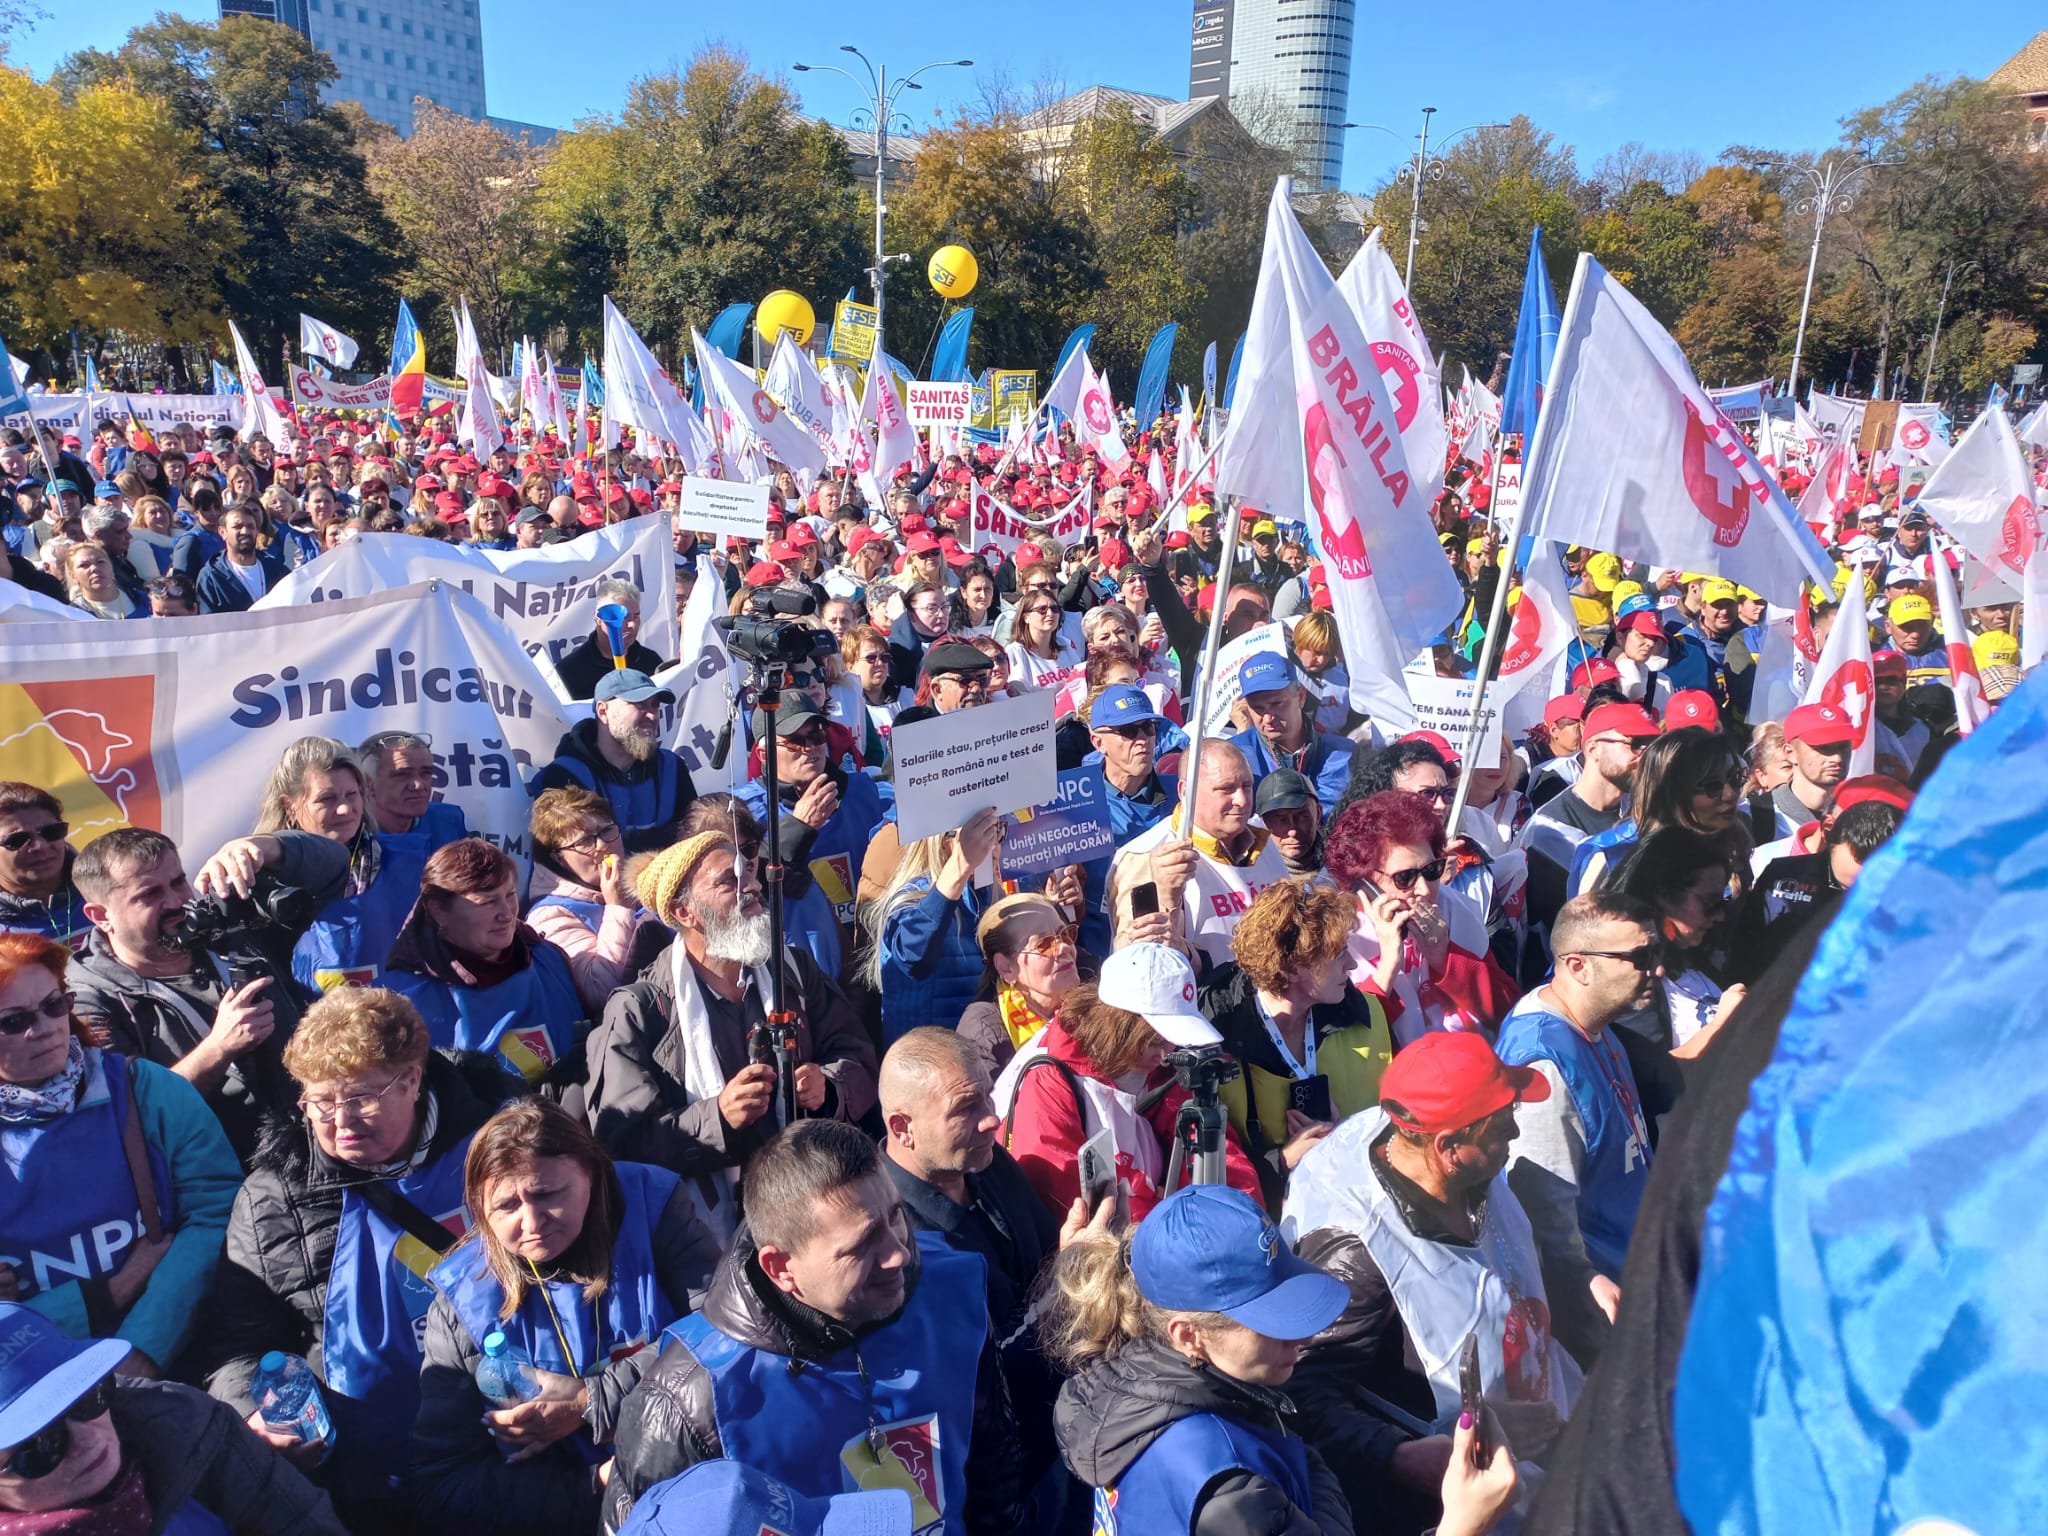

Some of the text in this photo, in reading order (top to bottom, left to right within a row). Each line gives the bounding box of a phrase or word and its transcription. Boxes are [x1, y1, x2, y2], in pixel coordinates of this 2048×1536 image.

[1376, 344, 1417, 372] SANITAS
[877, 375, 900, 428] BRĂILA
[910, 389, 969, 404] SANITAS
[913, 406, 965, 425] TIMIȘ
[1307, 323, 1410, 509] BRĂILA
[734, 496, 755, 504] pentru
[1252, 663, 1275, 673] SNPC
[1420, 720, 1437, 730] CU
[900, 719, 1050, 769] Salariile stau, prețurile cresc!
[908, 742, 1045, 788] Poșta Română nu e test de
[948, 771, 1010, 798] austeritate!
[1038, 776, 1094, 808] NPC
[1002, 830, 1113, 869] Separați IMPLORĂM
[1009, 819, 1101, 852] Uniți NEGOCIEM,
